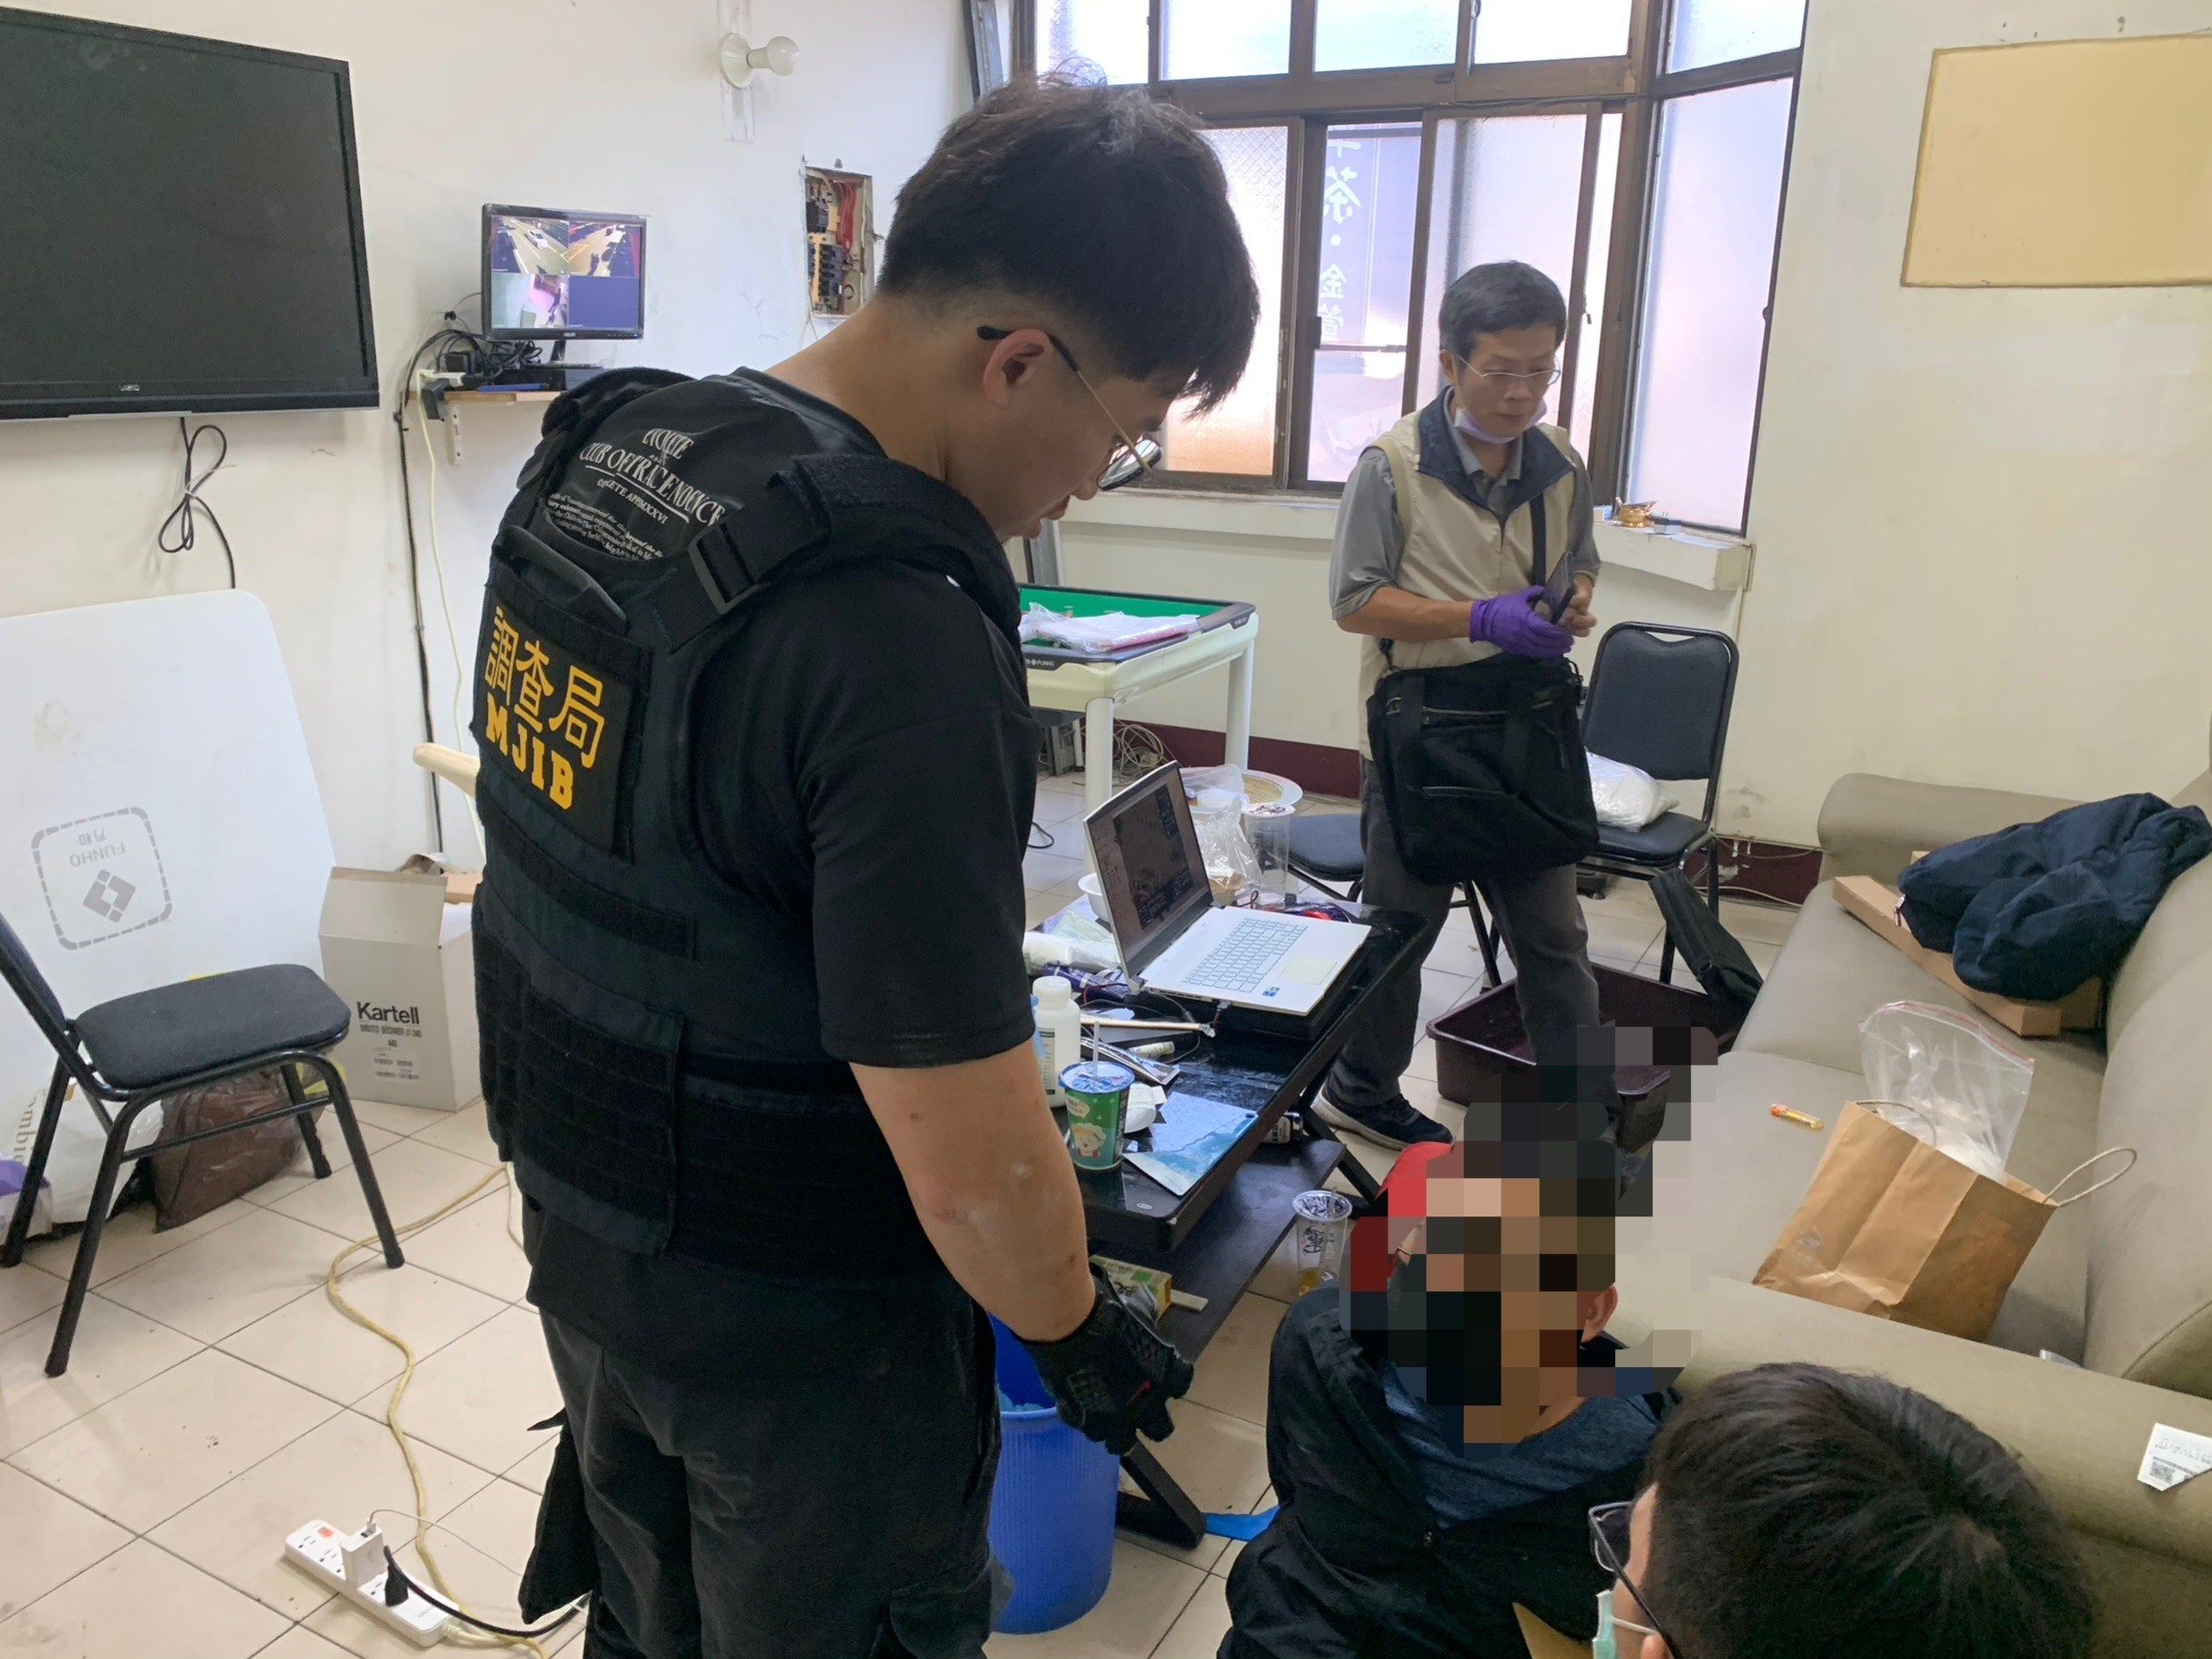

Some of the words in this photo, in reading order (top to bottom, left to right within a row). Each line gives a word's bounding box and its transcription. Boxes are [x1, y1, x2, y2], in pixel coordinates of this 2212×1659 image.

[485, 605, 604, 768] 調查局
[486, 691, 574, 809] MJIB
[70, 842, 125, 867] FUNHO
[357, 1001, 420, 1025] Kartell
